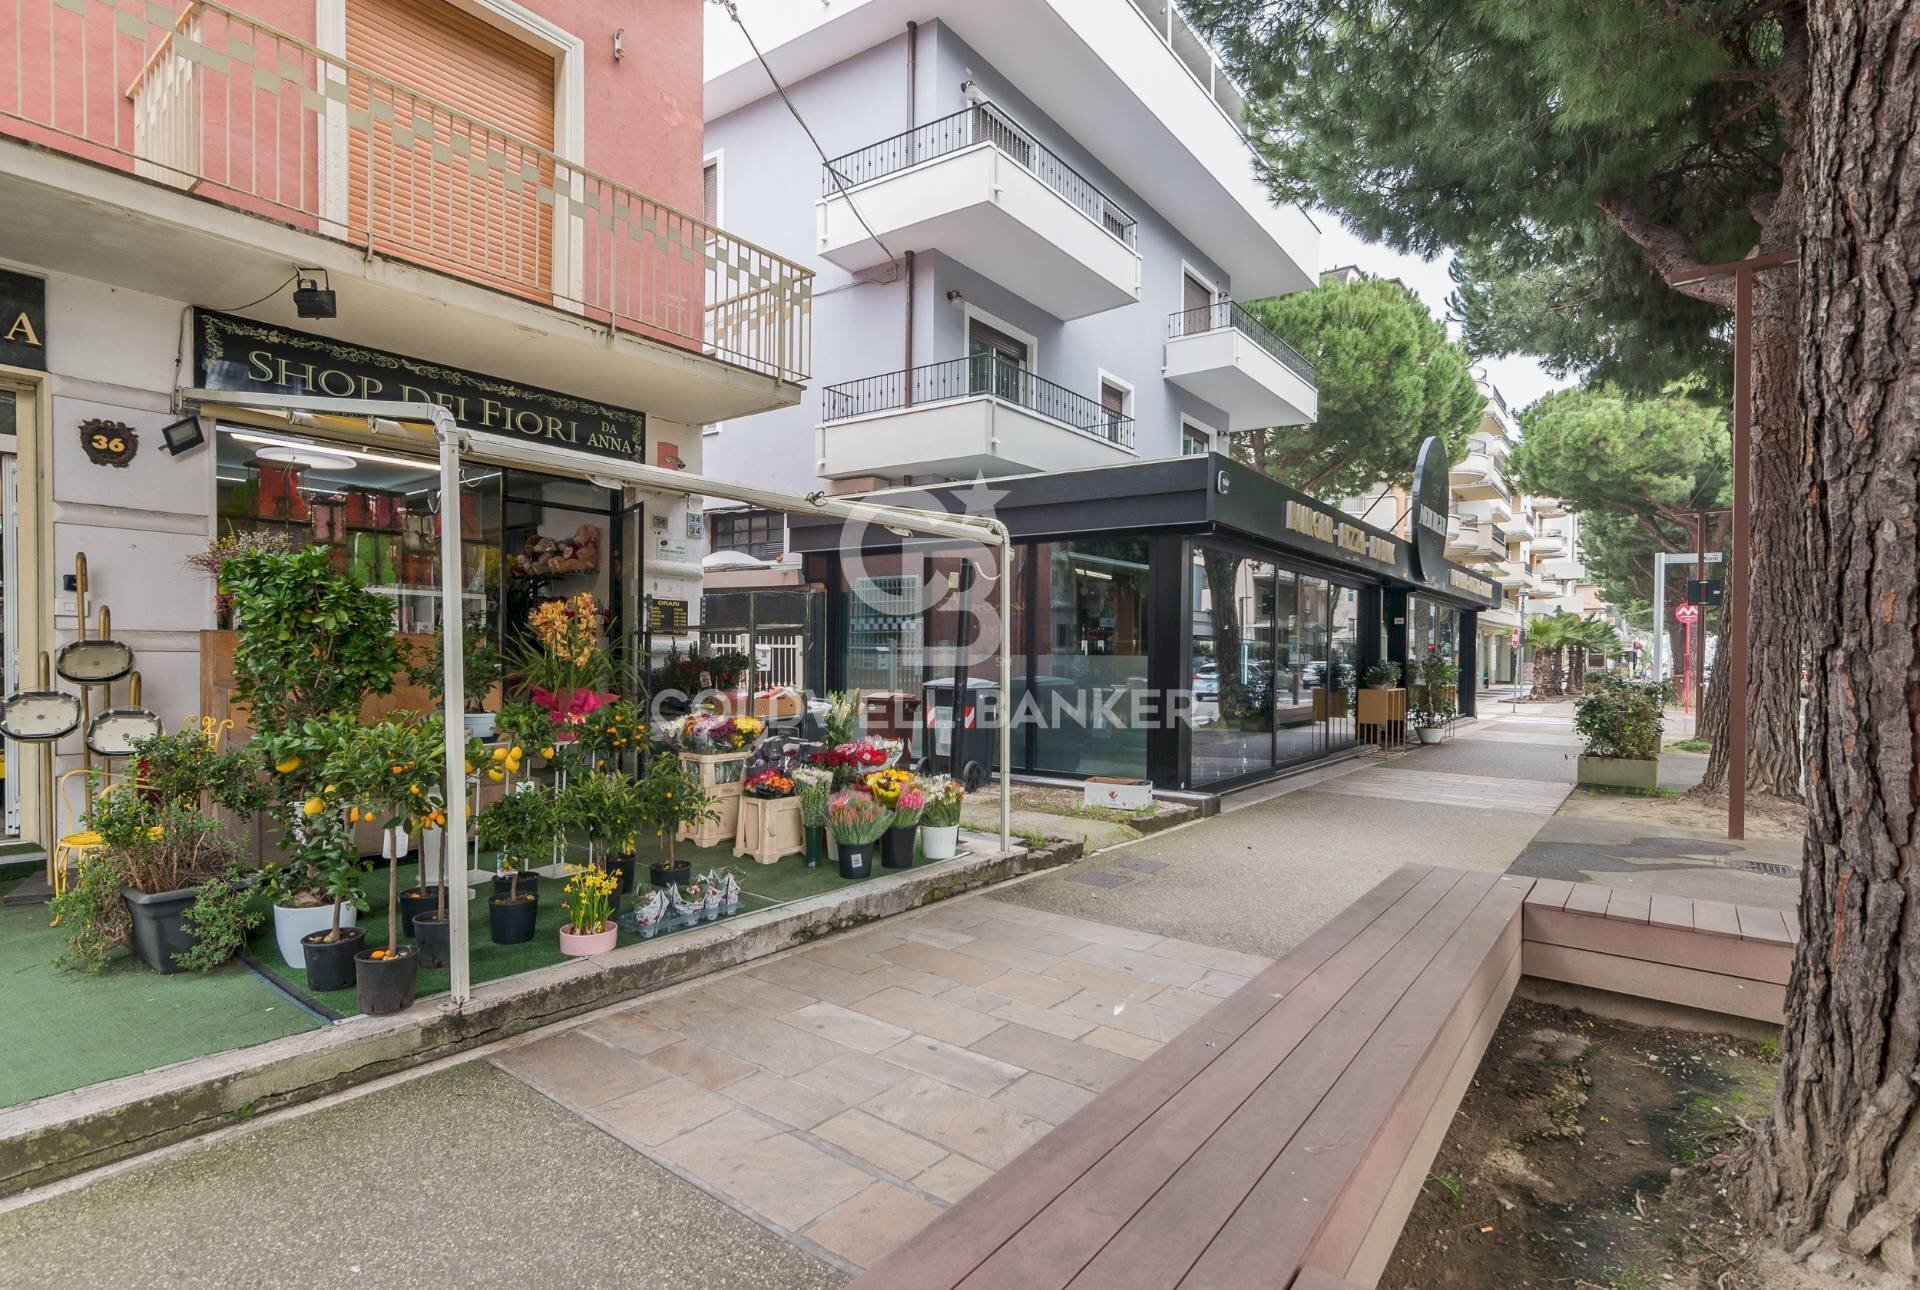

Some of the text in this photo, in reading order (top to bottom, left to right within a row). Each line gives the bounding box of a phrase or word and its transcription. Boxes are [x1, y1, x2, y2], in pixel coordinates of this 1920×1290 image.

[247, 350, 384, 400] SHOP
[478, 398, 580, 444] FIORI
[601, 421, 618, 434] DA
[92, 434, 125, 453] 36
[587, 433, 632, 454] ANNA
